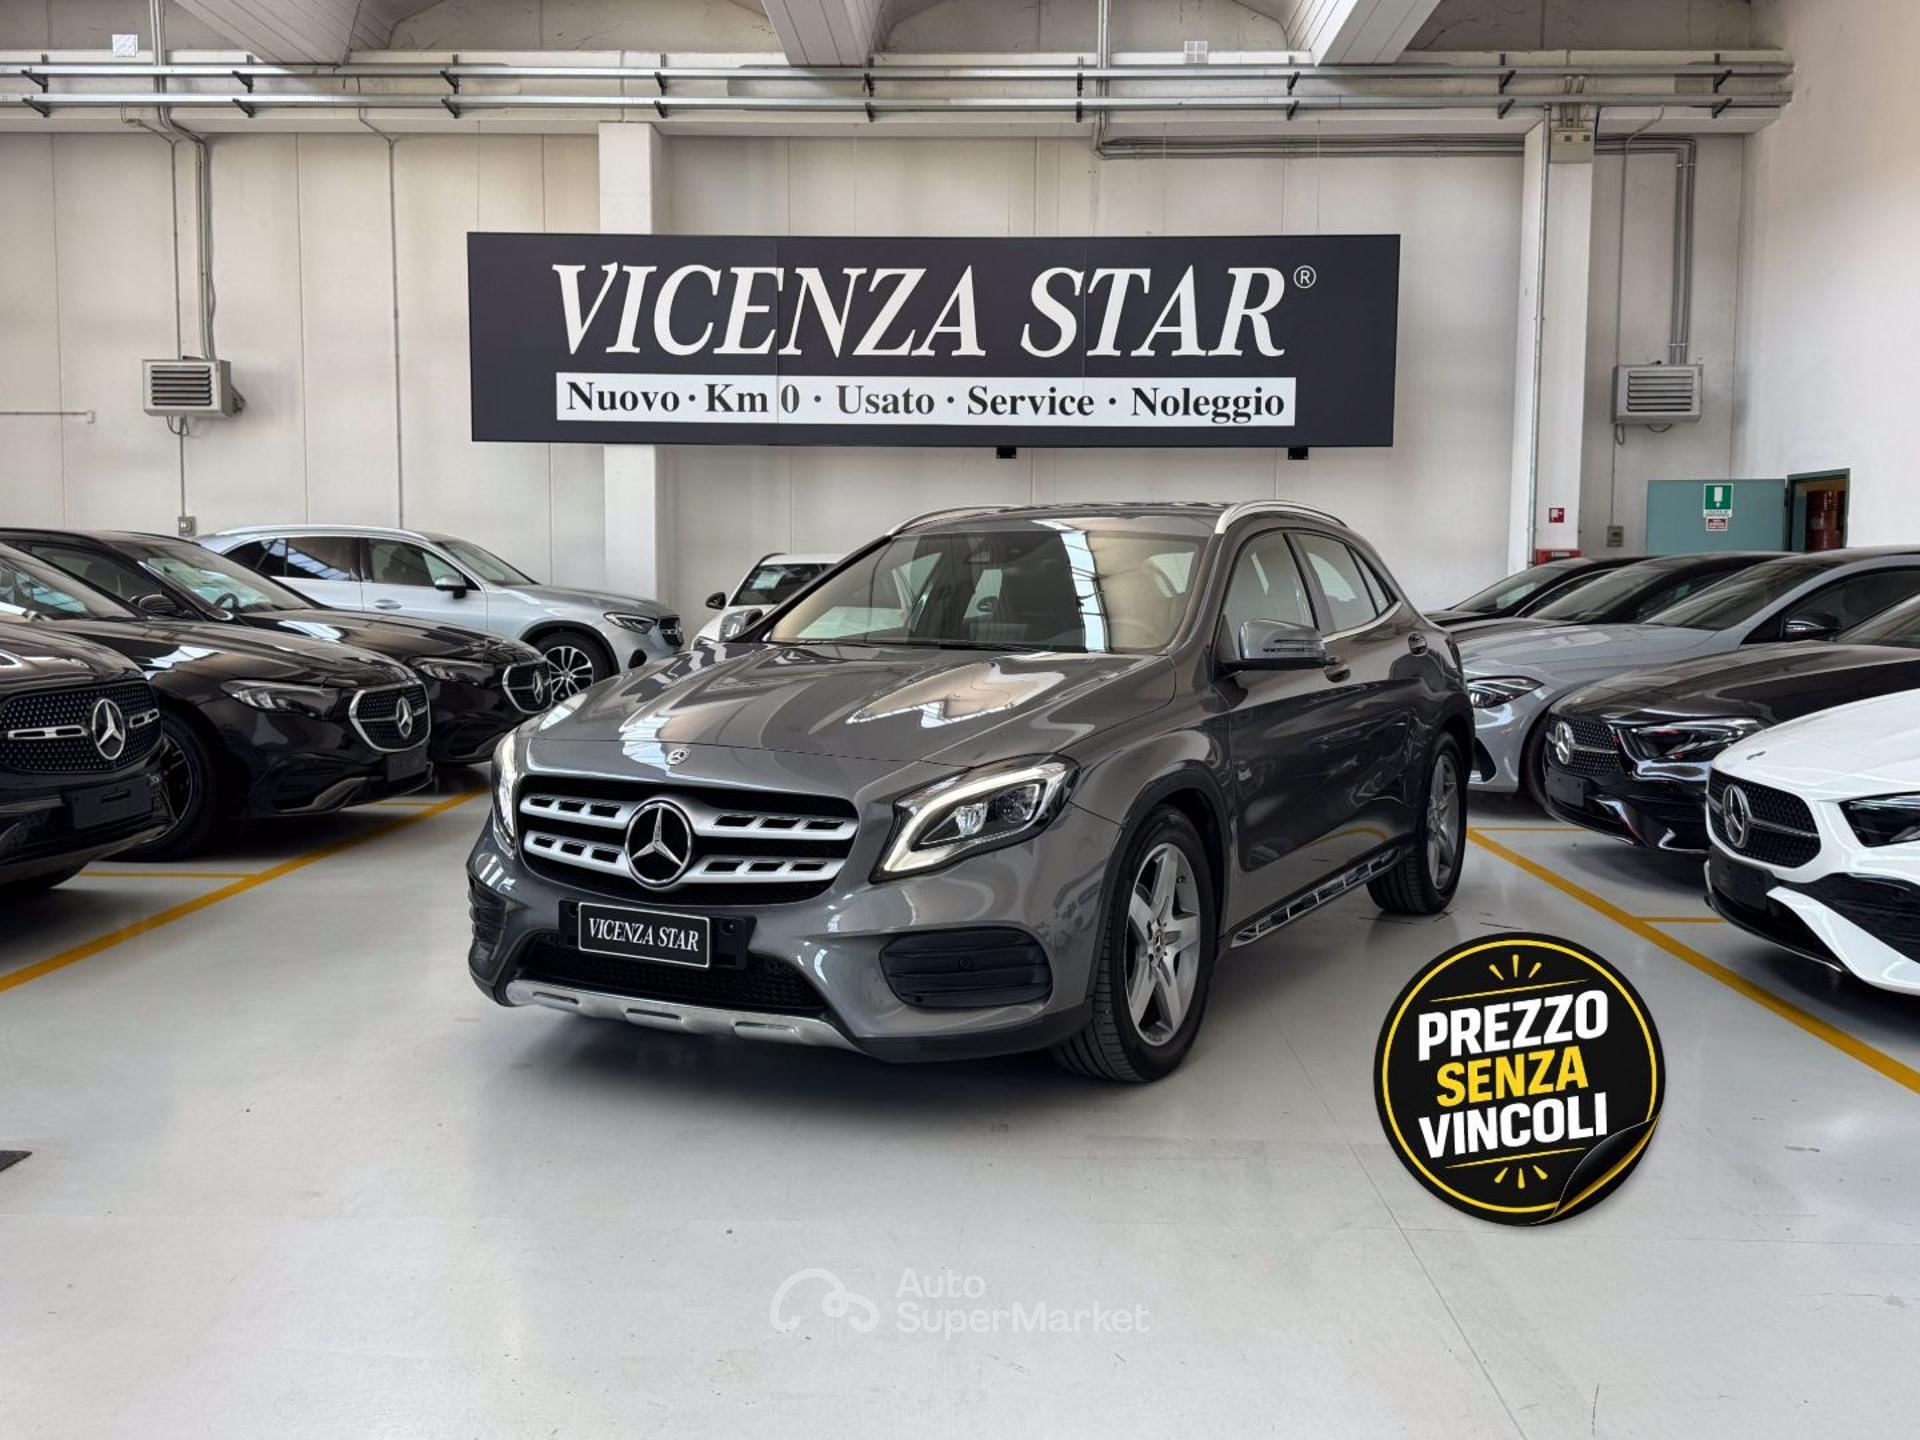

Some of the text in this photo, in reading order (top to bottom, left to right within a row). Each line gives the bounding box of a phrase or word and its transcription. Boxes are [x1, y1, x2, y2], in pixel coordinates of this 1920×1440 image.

[552, 261, 986, 358] VICENZA
[567, 381, 1285, 424] Nuovo Km 0 Usato Service Noleggio
[589, 917, 699, 951] VICENZA STAR
